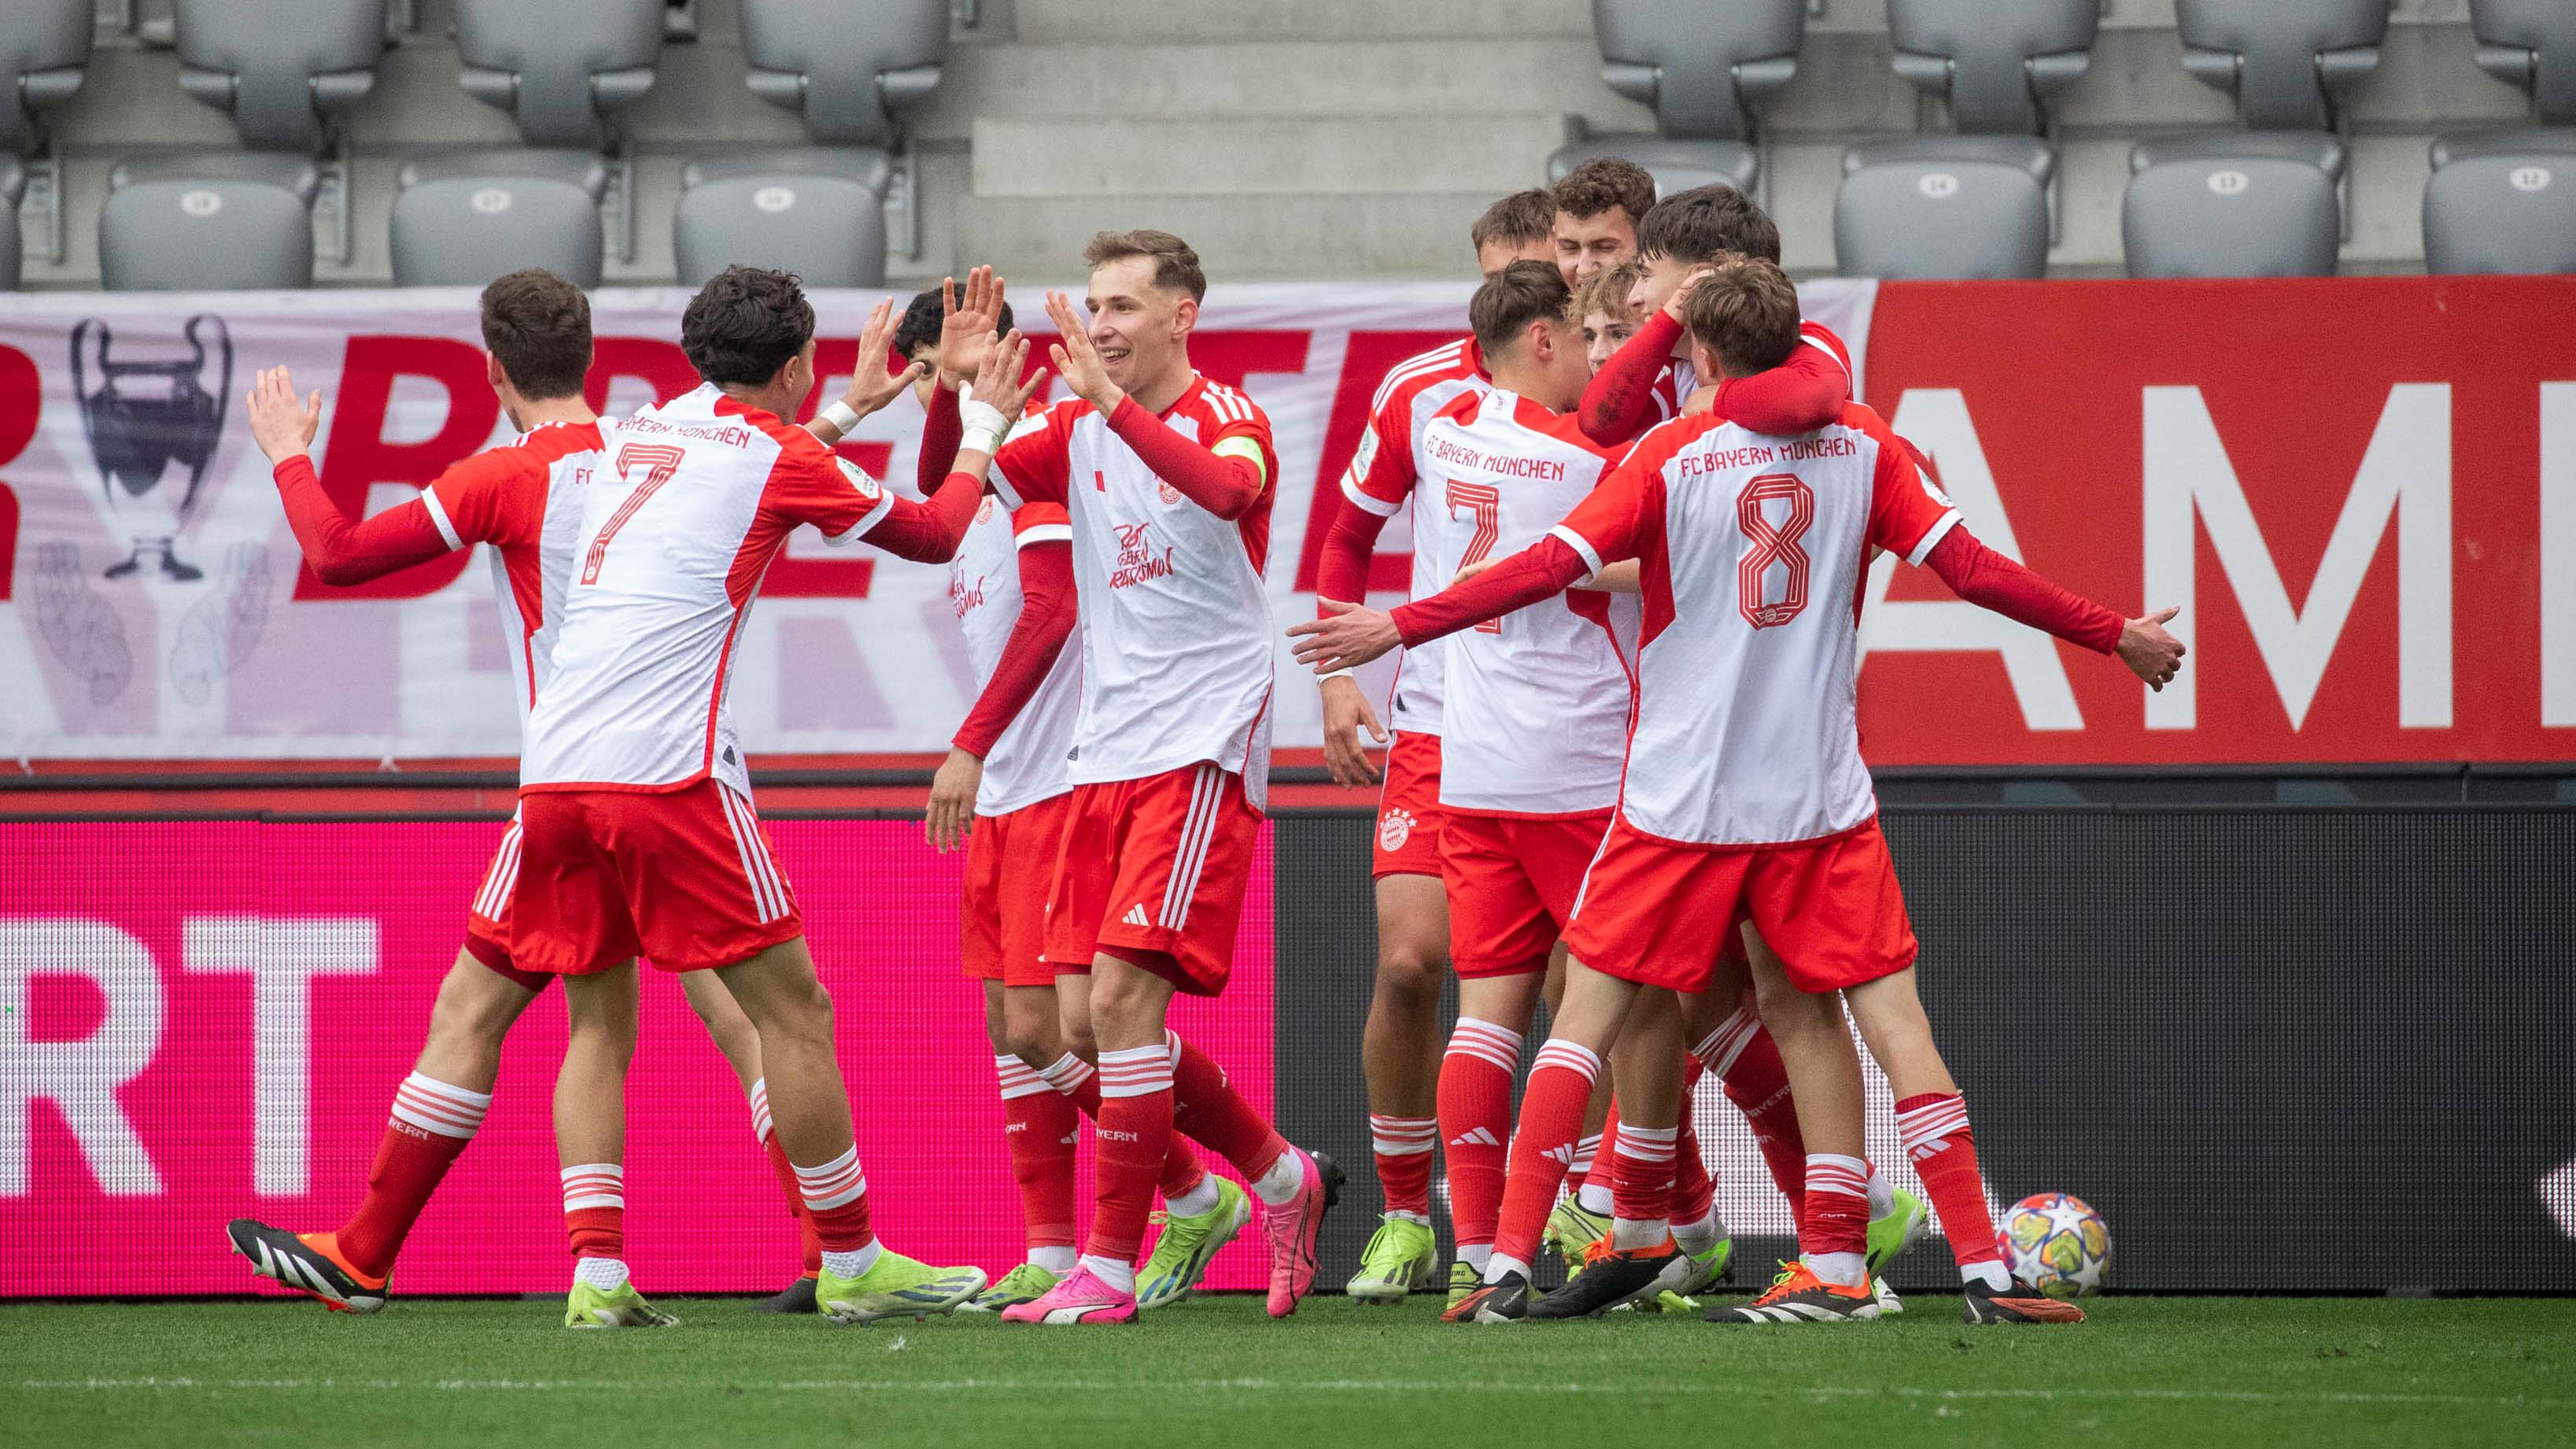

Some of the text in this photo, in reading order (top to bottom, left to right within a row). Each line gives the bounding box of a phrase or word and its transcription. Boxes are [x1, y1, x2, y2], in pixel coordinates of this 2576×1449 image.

[580, 442, 685, 585] 7
[1436, 440, 1484, 468] BAYERN
[1483, 453, 1565, 482] MÜNCHEN
[1681, 457, 1703, 478] FC
[1704, 446, 1774, 472] BAYERN
[1446, 478, 1500, 634] 7
[1736, 472, 1815, 630] 8
